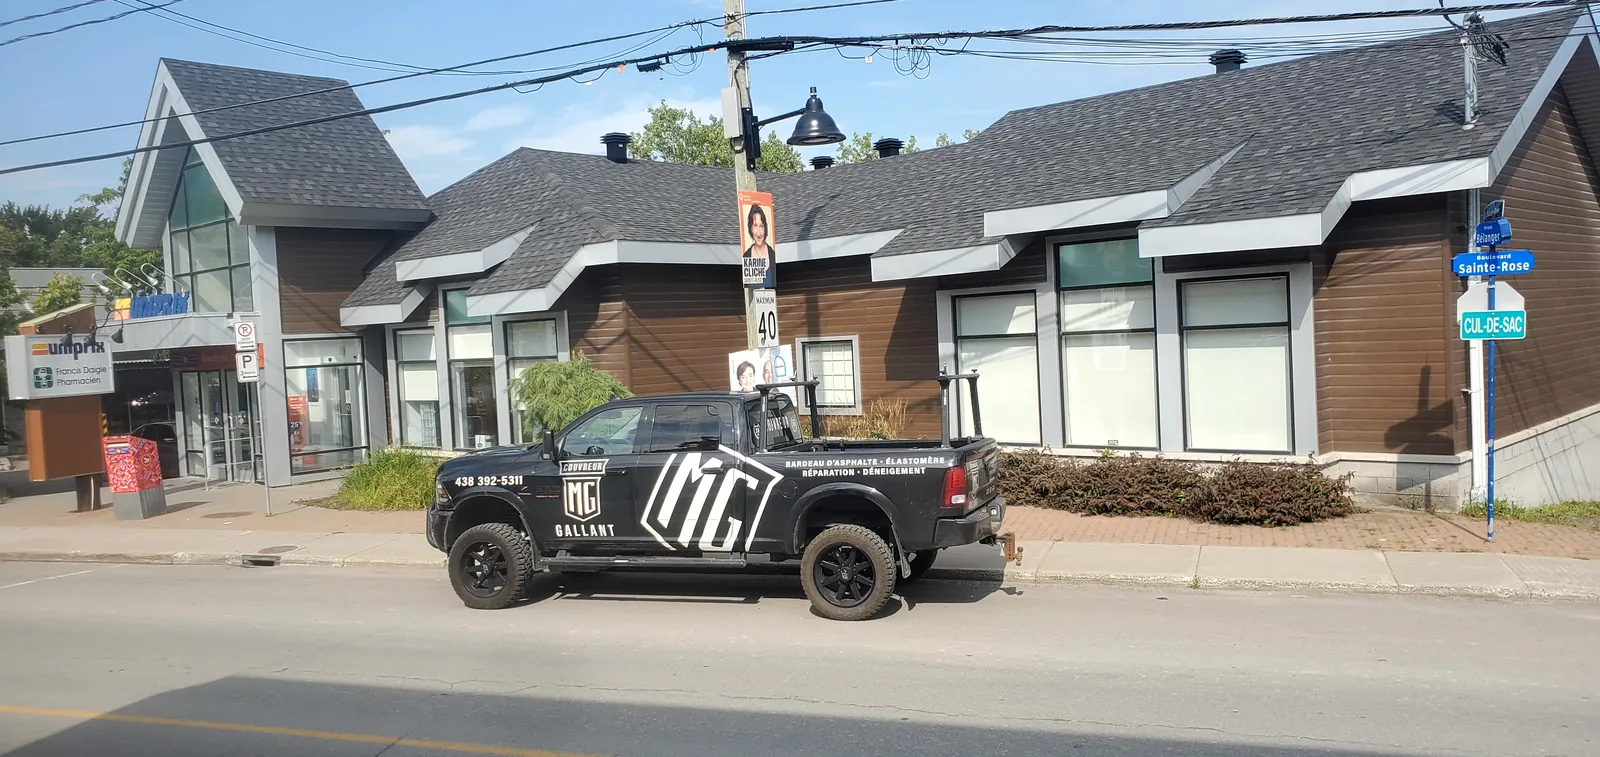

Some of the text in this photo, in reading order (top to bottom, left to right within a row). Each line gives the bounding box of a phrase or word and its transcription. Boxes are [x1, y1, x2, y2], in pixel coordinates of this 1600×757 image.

[1476, 233, 1500, 244] Bélanger
[743, 258, 767, 267] KARINE
[1476, 253, 1511, 261] Boulevard
[1458, 262, 1530, 274] Sainte-Rose
[758, 311, 776, 340] 40
[1463, 316, 1523, 334] CUL-DE-SAC
[83, 366, 107, 375] Daigle
[563, 462, 603, 472] COUVREUR
[785, 456, 945, 468] BARDEAU D'ASPHALTE ÉLASTOMÈRE
[802, 466, 926, 477] RÉPARATION DÉNEIGEMENT
[455, 476, 523, 487] 438 392-5311
[567, 481, 597, 514] MG
[657, 452, 759, 552] MG
[555, 524, 615, 537] GALLANT
